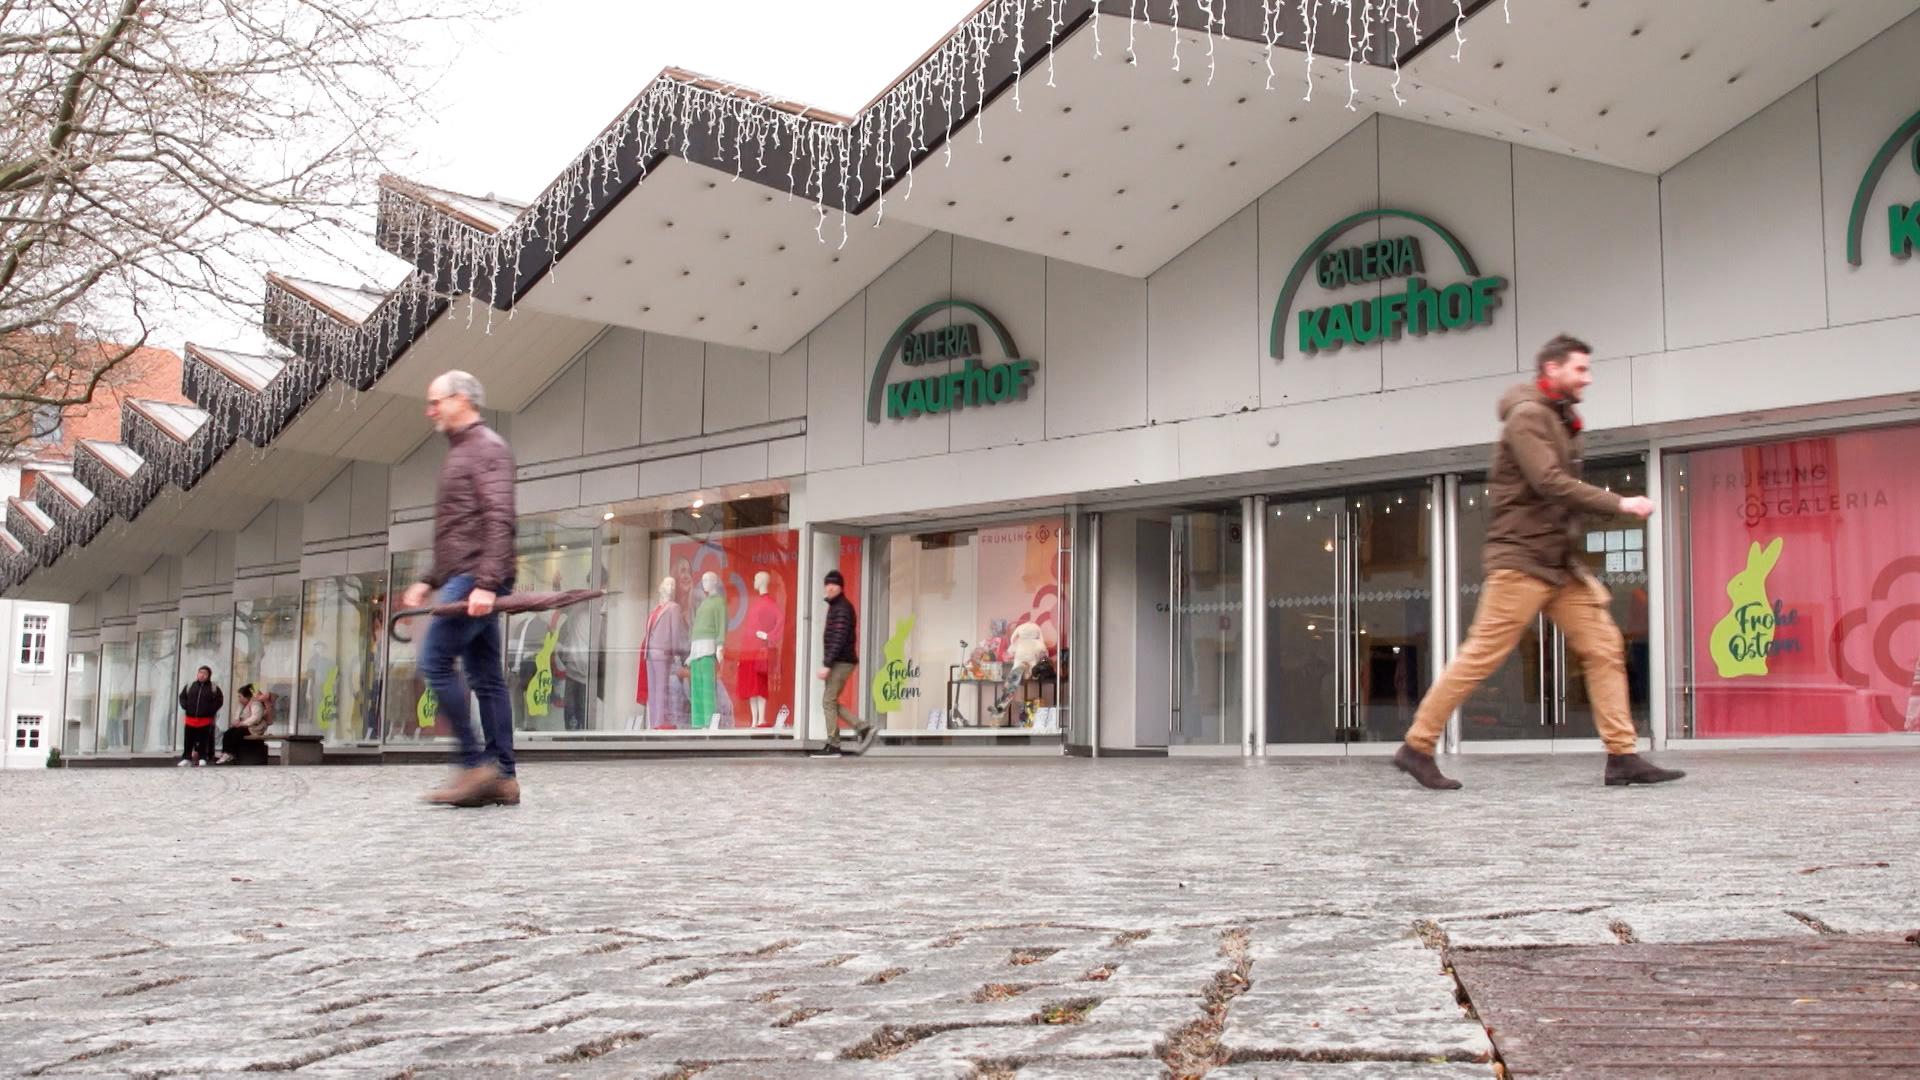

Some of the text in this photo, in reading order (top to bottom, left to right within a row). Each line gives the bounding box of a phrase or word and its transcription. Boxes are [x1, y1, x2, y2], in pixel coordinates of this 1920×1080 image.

[1315, 235, 1425, 288] GALERIA
[901, 323, 980, 366] GALERIA
[1777, 489, 1888, 515] GALERIA
[1735, 599, 1798, 633] Frohe
[887, 659, 920, 681] Frohe
[882, 681, 921, 701] Ostern
